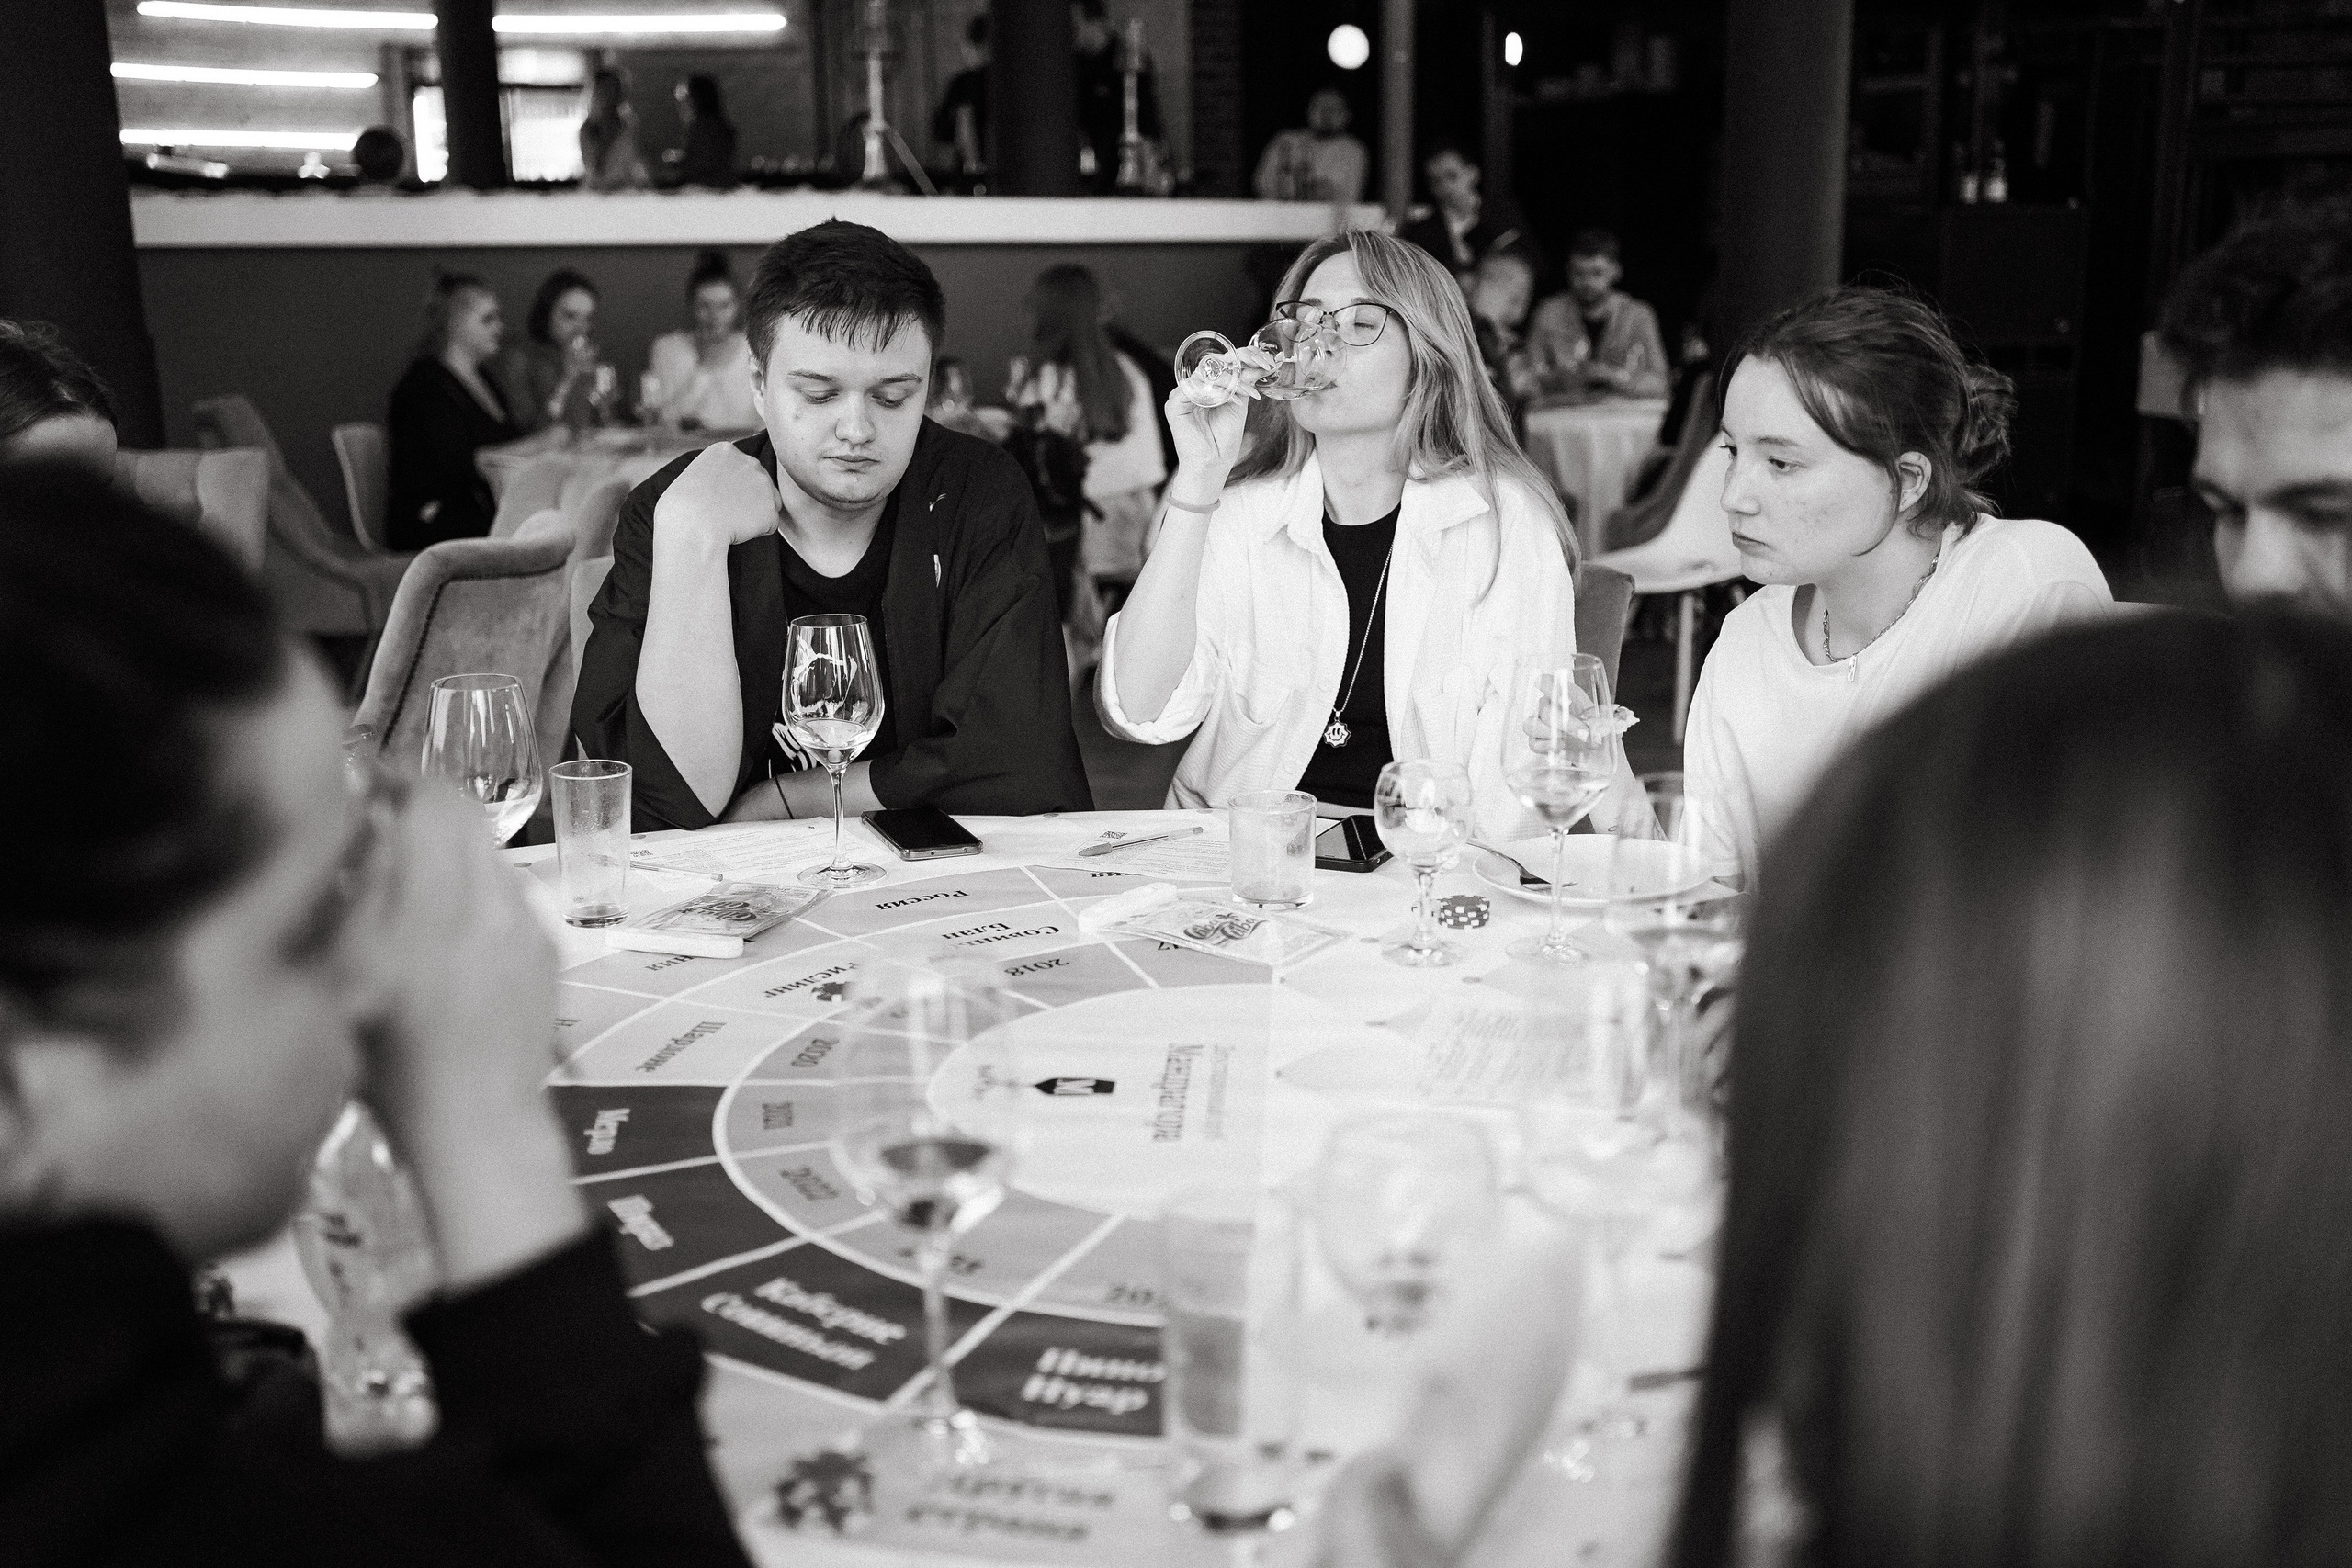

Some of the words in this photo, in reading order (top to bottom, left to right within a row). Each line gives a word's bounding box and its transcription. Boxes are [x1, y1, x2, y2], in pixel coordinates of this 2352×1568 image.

[874, 888, 970, 912] Россия
[941, 921, 1012, 942] Блан
[1004, 957, 1070, 978] 2018
[636, 1021, 728, 1074] Шардоне
